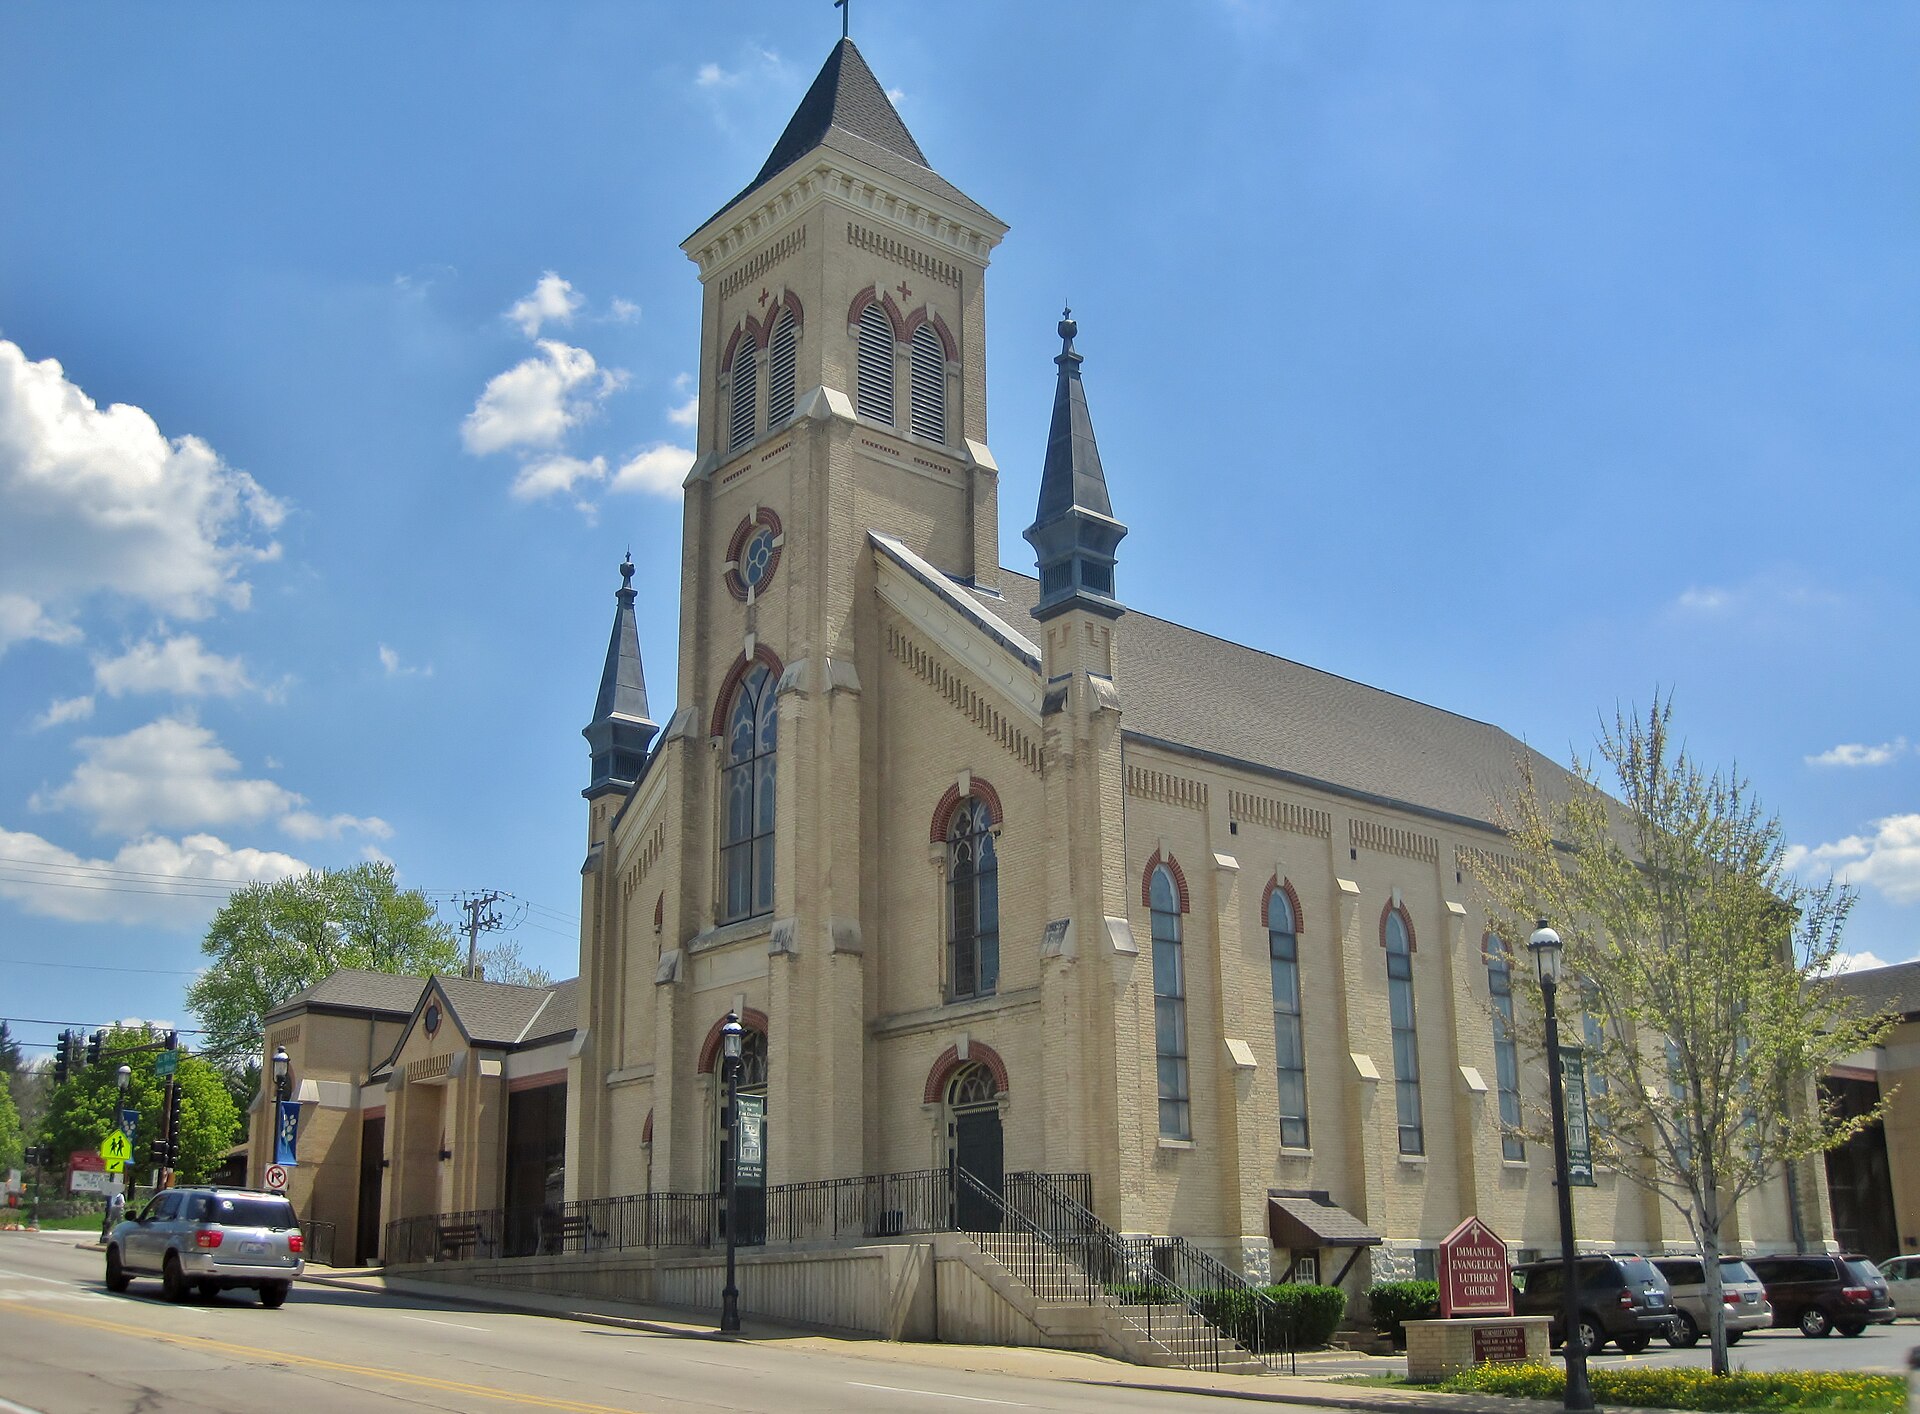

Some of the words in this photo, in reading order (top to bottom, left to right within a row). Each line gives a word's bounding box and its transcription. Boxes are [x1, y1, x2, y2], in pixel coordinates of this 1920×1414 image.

[1456, 1246, 1496, 1257] IMMANUEL
[1452, 1259, 1503, 1270] EVANGELICAL
[1459, 1272, 1499, 1283] LUTHERAN
[1464, 1285, 1495, 1296] CHURCH
